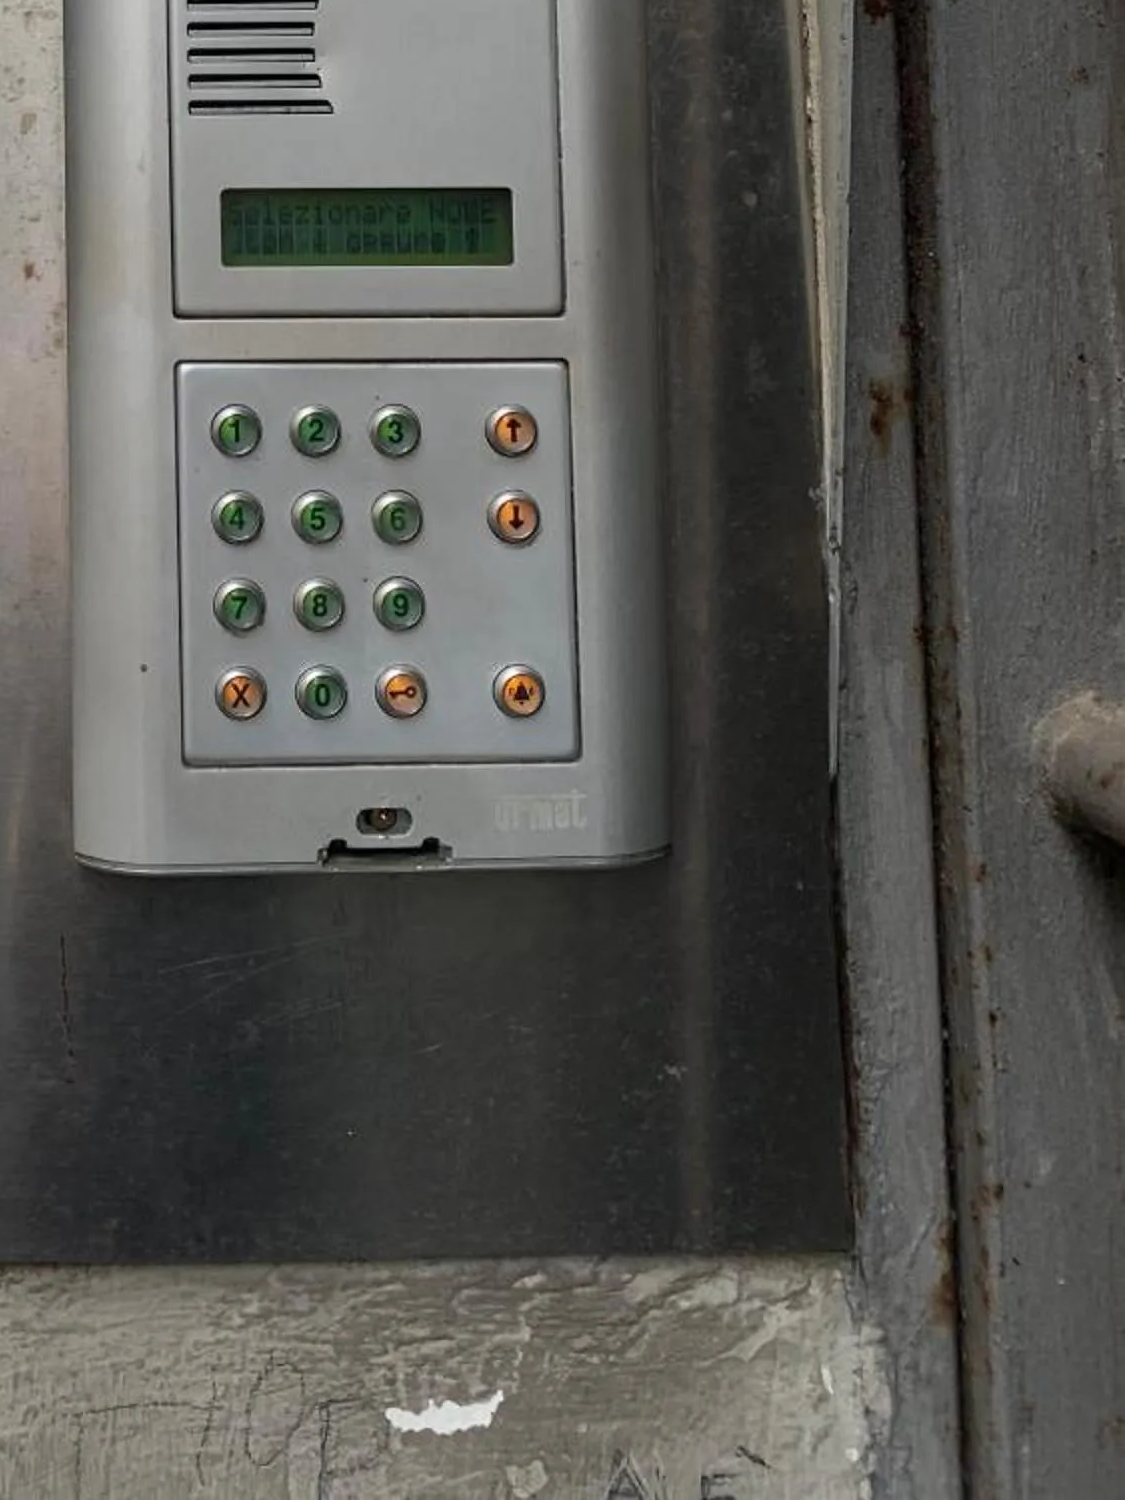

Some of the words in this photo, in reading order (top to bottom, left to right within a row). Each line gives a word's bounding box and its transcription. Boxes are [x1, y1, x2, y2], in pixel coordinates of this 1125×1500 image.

[229, 418, 242, 443] 1
[307, 418, 325, 443] 2
[387, 418, 405, 444] 3
[229, 507, 246, 531] 4
[309, 506, 327, 531] 5
[389, 506, 407, 532] 6
[232, 594, 248, 619] 7
[312, 593, 329, 618] 8
[392, 593, 410, 619] 9
[313, 683, 331, 708] 0
